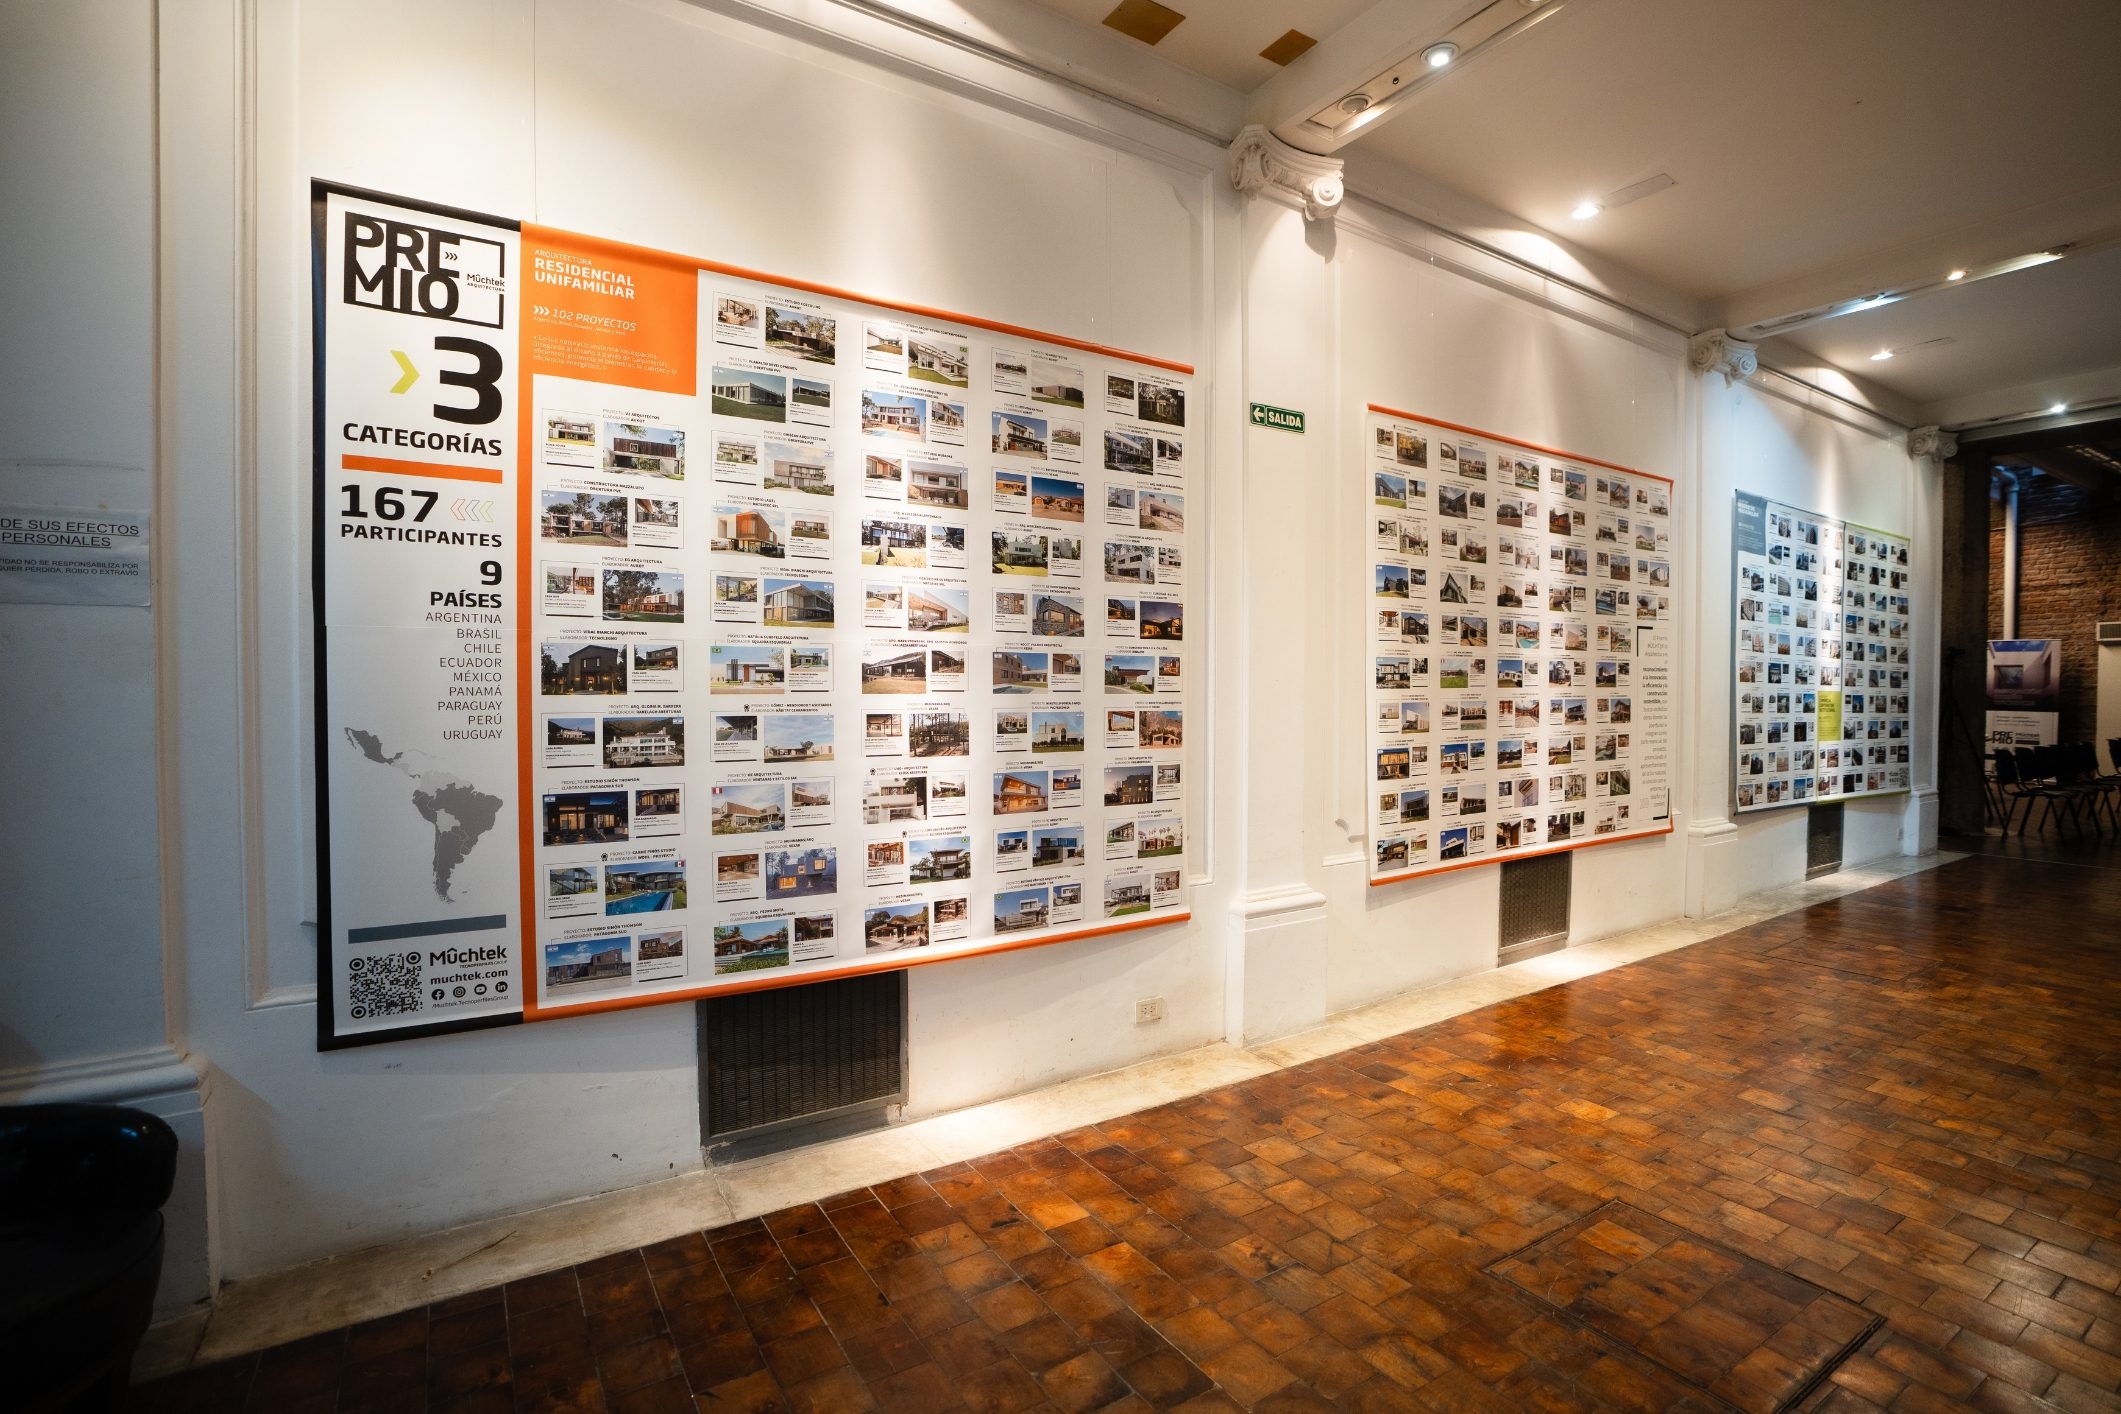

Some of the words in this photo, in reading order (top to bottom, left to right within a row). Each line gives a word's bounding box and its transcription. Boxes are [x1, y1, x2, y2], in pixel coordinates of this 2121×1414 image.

[534, 250, 592, 265] ARQUITECTURA
[535, 258, 634, 286] RESIDENCIAL
[535, 270, 634, 299] UNIFAMILIAR
[553, 309, 574, 320] 102
[576, 314, 636, 331] PROYECTOS
[434, 336, 502, 425] 3
[1268, 411, 1302, 428] SALIDA
[343, 422, 502, 456] CATEGORÍAS
[342, 484, 438, 522] 167
[0, 518, 22, 528] DE
[28, 520, 60, 530] SUS
[66, 522, 139, 535] EFECTOS
[2, 532, 111, 546] PERSONALES
[342, 524, 502, 548] PARTICIPANTES
[480, 560, 502, 586] 9
[430, 590, 502, 608] PAÍSES
[426, 612, 502, 624] ARGENTINA
[457, 628, 502, 640] BRASIL
[464, 644, 502, 654] CHILE
[440, 658, 502, 668] ECUADOR
[454, 671, 502, 682] MÉXICO
[450, 685, 502, 696] PANAMÁ
[438, 701, 502, 711] PARAGUAY
[468, 712, 502, 725] PERÚ
[444, 730, 503, 740] URUGUAY
[430, 945, 507, 966] Mûchtek
[430, 970, 508, 985] muchtek.com
